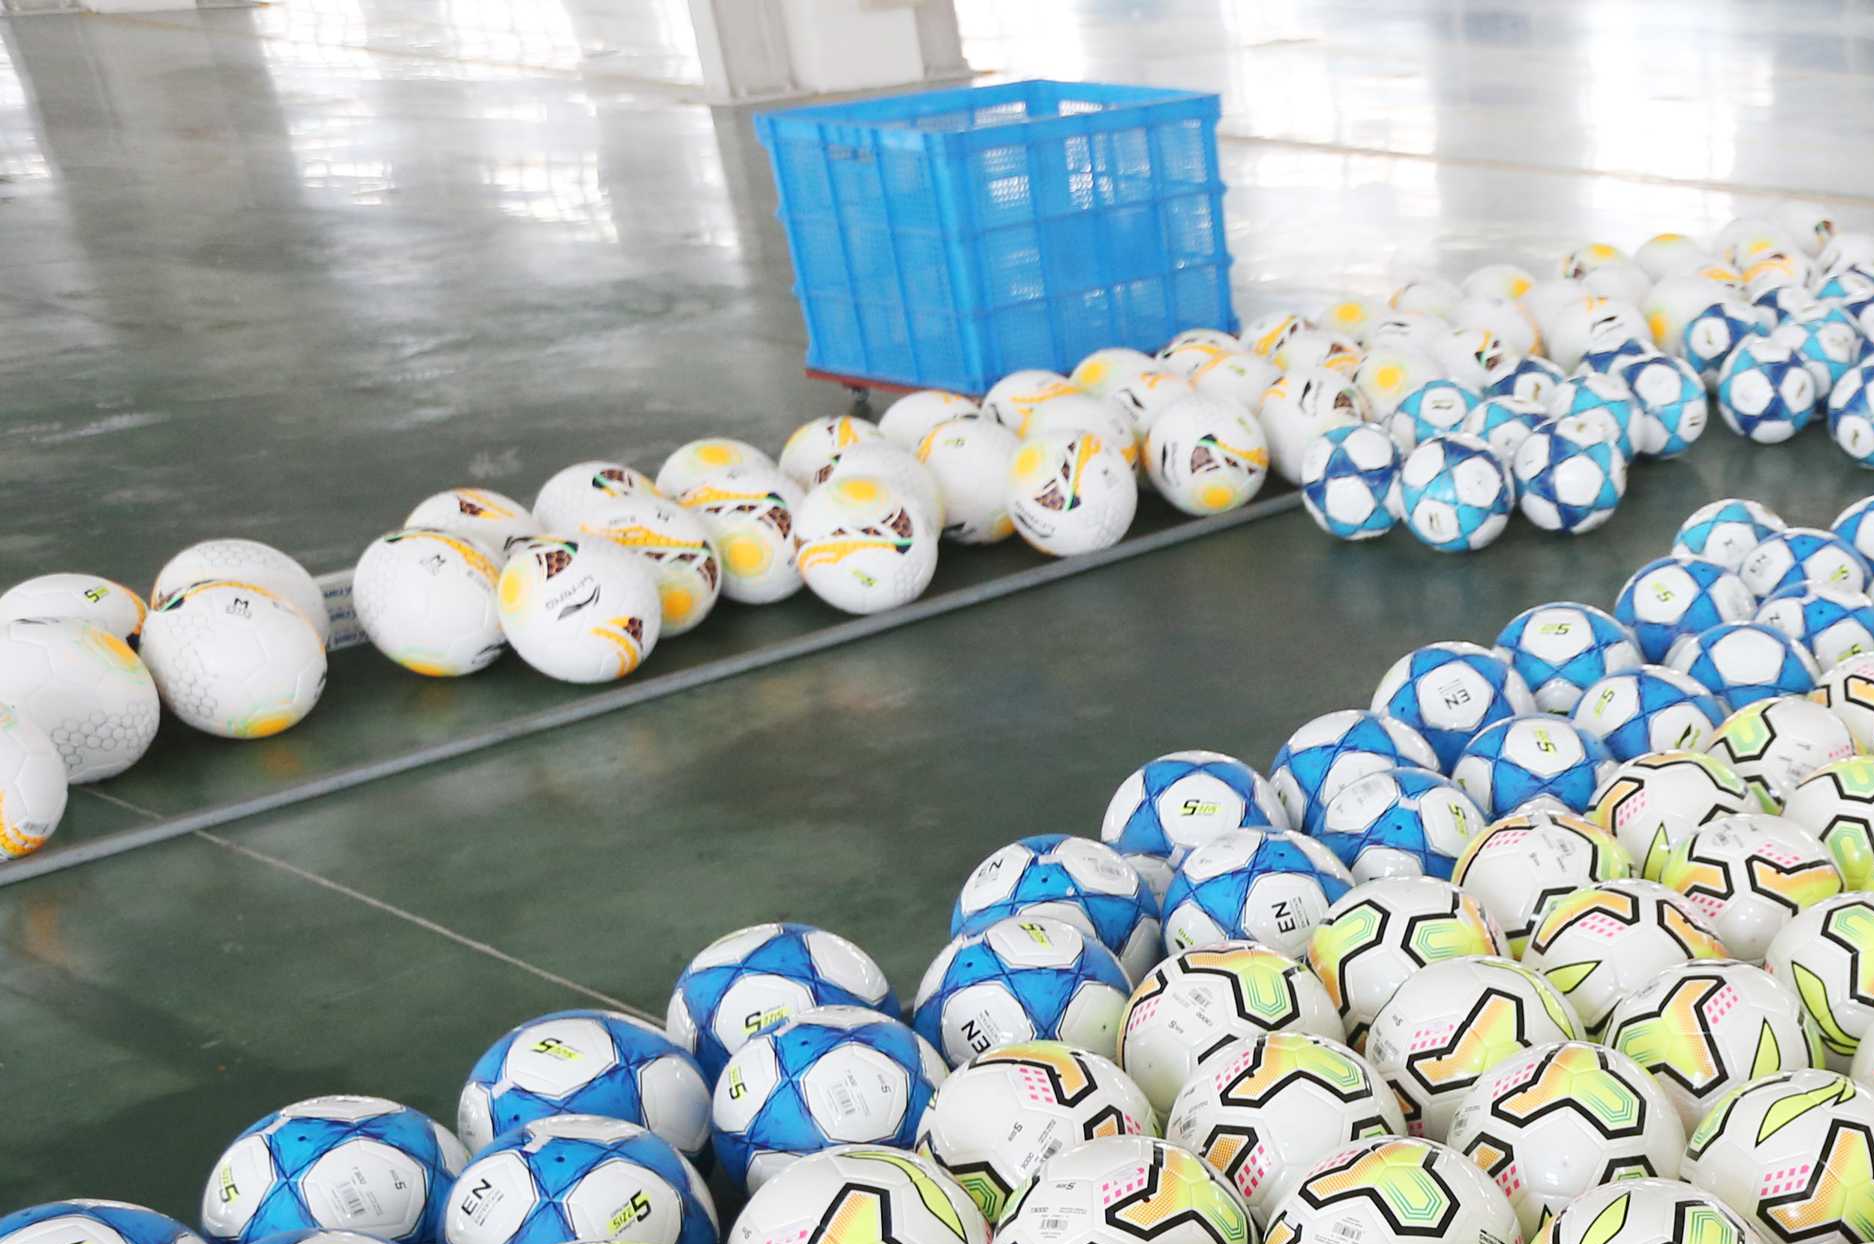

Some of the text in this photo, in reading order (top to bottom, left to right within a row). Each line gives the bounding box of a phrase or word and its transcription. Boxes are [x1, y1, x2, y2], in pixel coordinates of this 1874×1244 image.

[1444, 689, 1470, 710] EN
[1181, 800, 1201, 816] 5
[1271, 901, 1297, 932] EN
[745, 1012, 762, 1034] 5
[961, 1019, 991, 1054] EN
[729, 1082, 747, 1100] 5
[220, 1184, 241, 1204] 5
[460, 1178, 493, 1216] EN
[611, 1189, 651, 1230] SIZE 5
